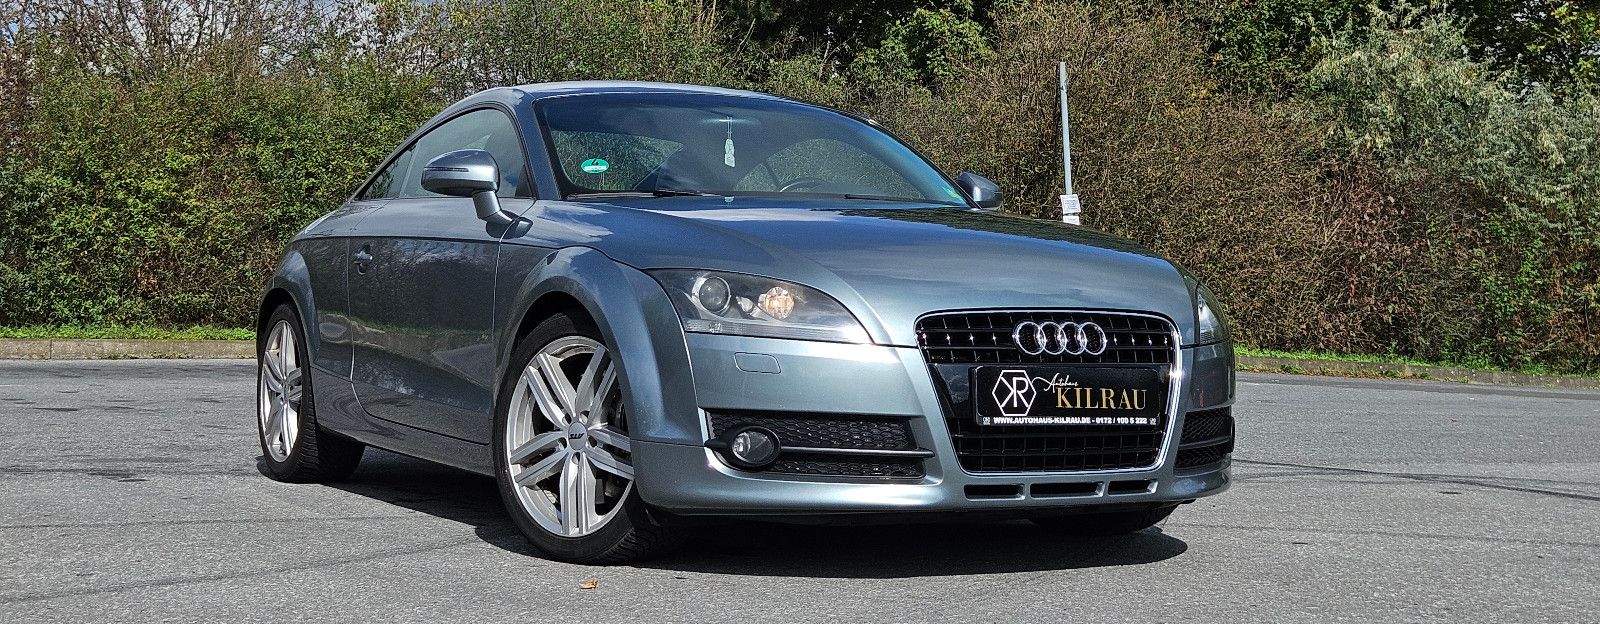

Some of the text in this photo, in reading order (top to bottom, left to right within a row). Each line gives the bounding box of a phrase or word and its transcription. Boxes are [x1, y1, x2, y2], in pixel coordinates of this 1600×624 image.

[1032, 372, 1079, 394] Autohaus
[1055, 388, 1147, 410] KILRAU
[993, 416, 1091, 424] WWW.AUTOHAUS-KILRAU.DE
[1096, 416, 1112, 424] 0172
[1117, 416, 1129, 424] 100
[1135, 416, 1147, 424] 222
